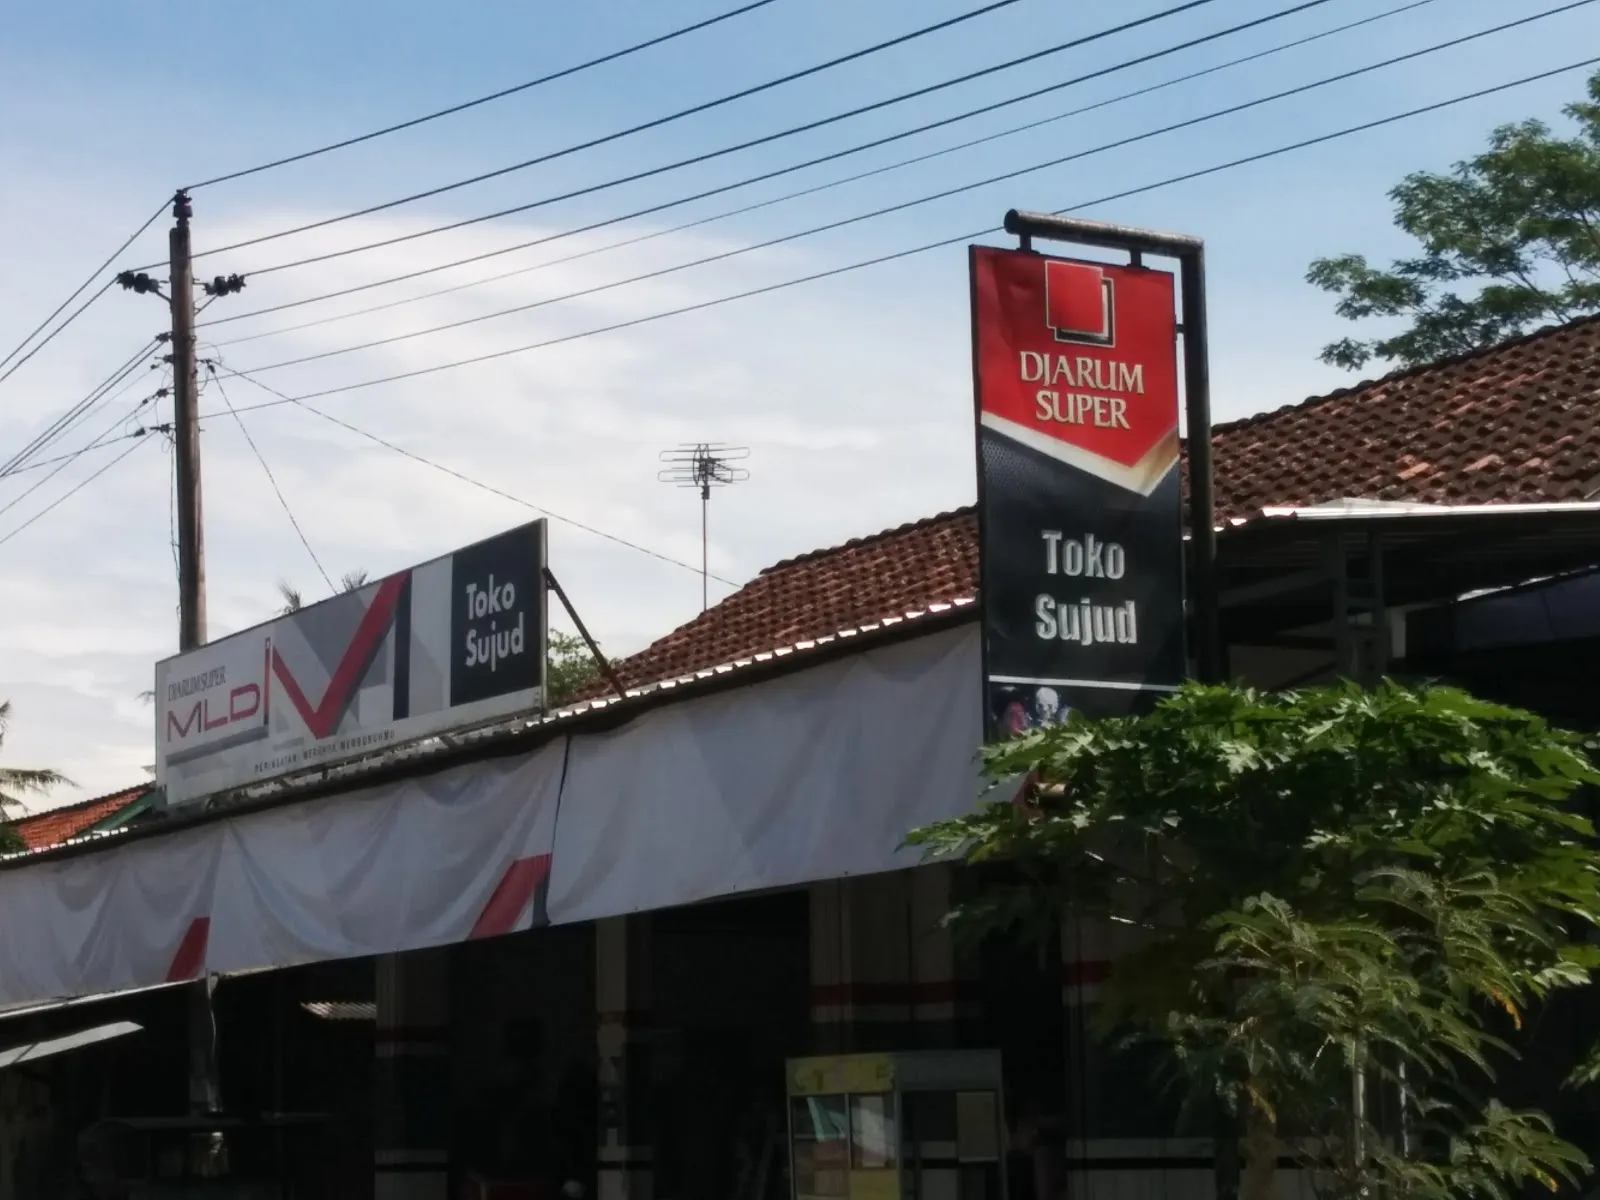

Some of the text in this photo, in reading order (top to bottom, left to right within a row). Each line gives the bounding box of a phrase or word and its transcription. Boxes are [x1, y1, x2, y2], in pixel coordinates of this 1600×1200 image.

[1020, 350, 1145, 394] DJARUM
[1035, 390, 1131, 430] SUPER
[1041, 529, 1126, 579] Toko
[465, 573, 515, 620] Toko
[1035, 593, 1138, 646] Sujud
[465, 611, 524, 672] Sujud
[167, 683, 261, 742] MLD
